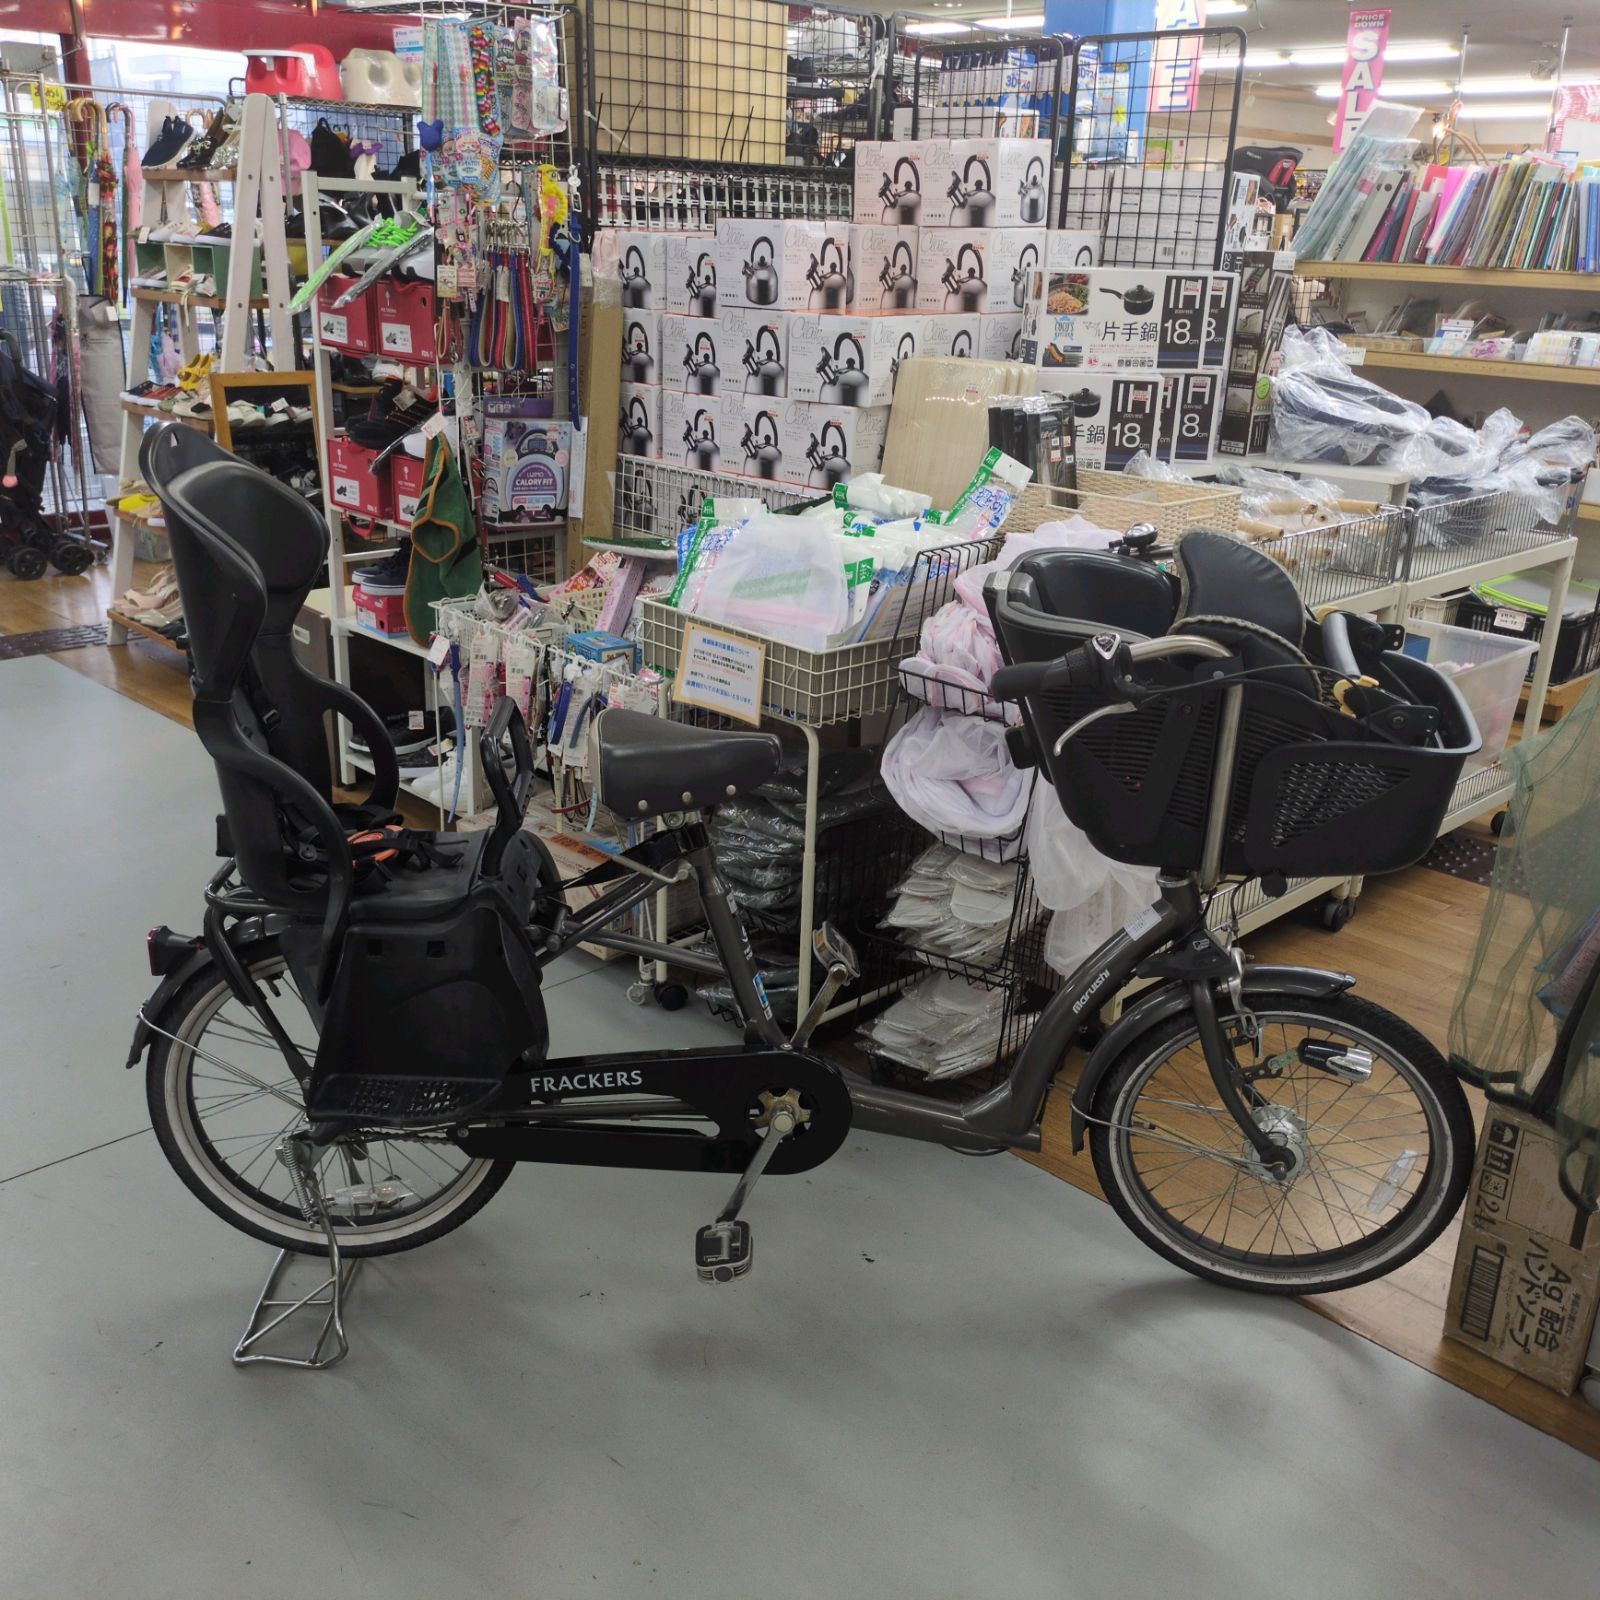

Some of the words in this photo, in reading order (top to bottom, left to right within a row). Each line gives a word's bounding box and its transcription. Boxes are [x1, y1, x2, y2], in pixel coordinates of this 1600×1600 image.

[1354, 20, 1384, 28] DOWN
[1157, 0, 1199, 110] ALE
[1169, 278, 1202, 309] IH
[1101, 320, 1158, 343] 片手鍋
[1117, 383, 1153, 413] IH
[1074, 424, 1106, 445] 手鍋
[515, 478, 543, 486] CALORY
[543, 478, 553, 486] FIT
[530, 1070, 643, 1093] FRACKERS
[1509, 1237, 1550, 1355] ハンドソープ
